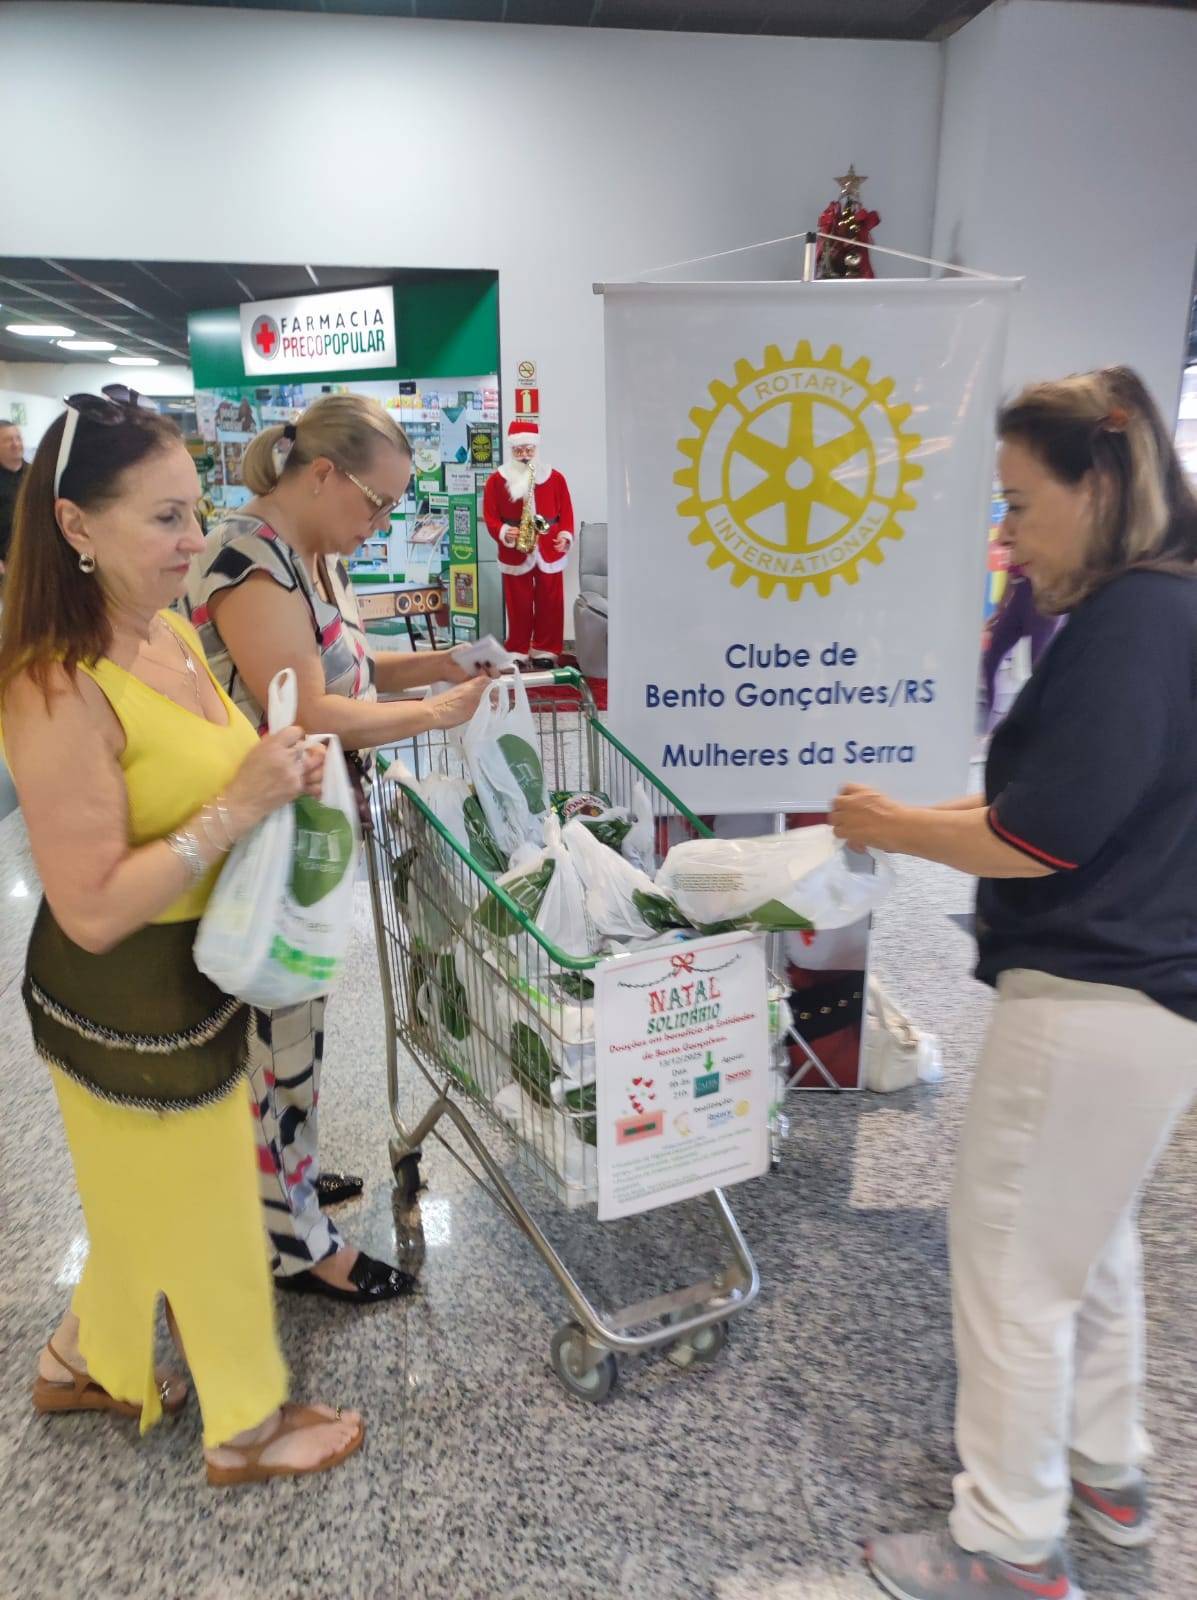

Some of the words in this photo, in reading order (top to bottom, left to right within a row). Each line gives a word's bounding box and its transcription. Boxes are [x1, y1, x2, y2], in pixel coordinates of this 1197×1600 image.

[281, 308, 384, 333] FARMACIA
[753, 372, 854, 400] ROTARY
[714, 514, 884, 575] INTERNATIONAL
[725, 643, 810, 669] Clube
[820, 642, 858, 667] de
[645, 684, 724, 708] Bento
[735, 678, 936, 710] Gonçalves/RS
[661, 743, 788, 767] Mulheres
[799, 742, 835, 765] da
[844, 741, 915, 763] Serra
[648, 976, 721, 1014] NATAL
